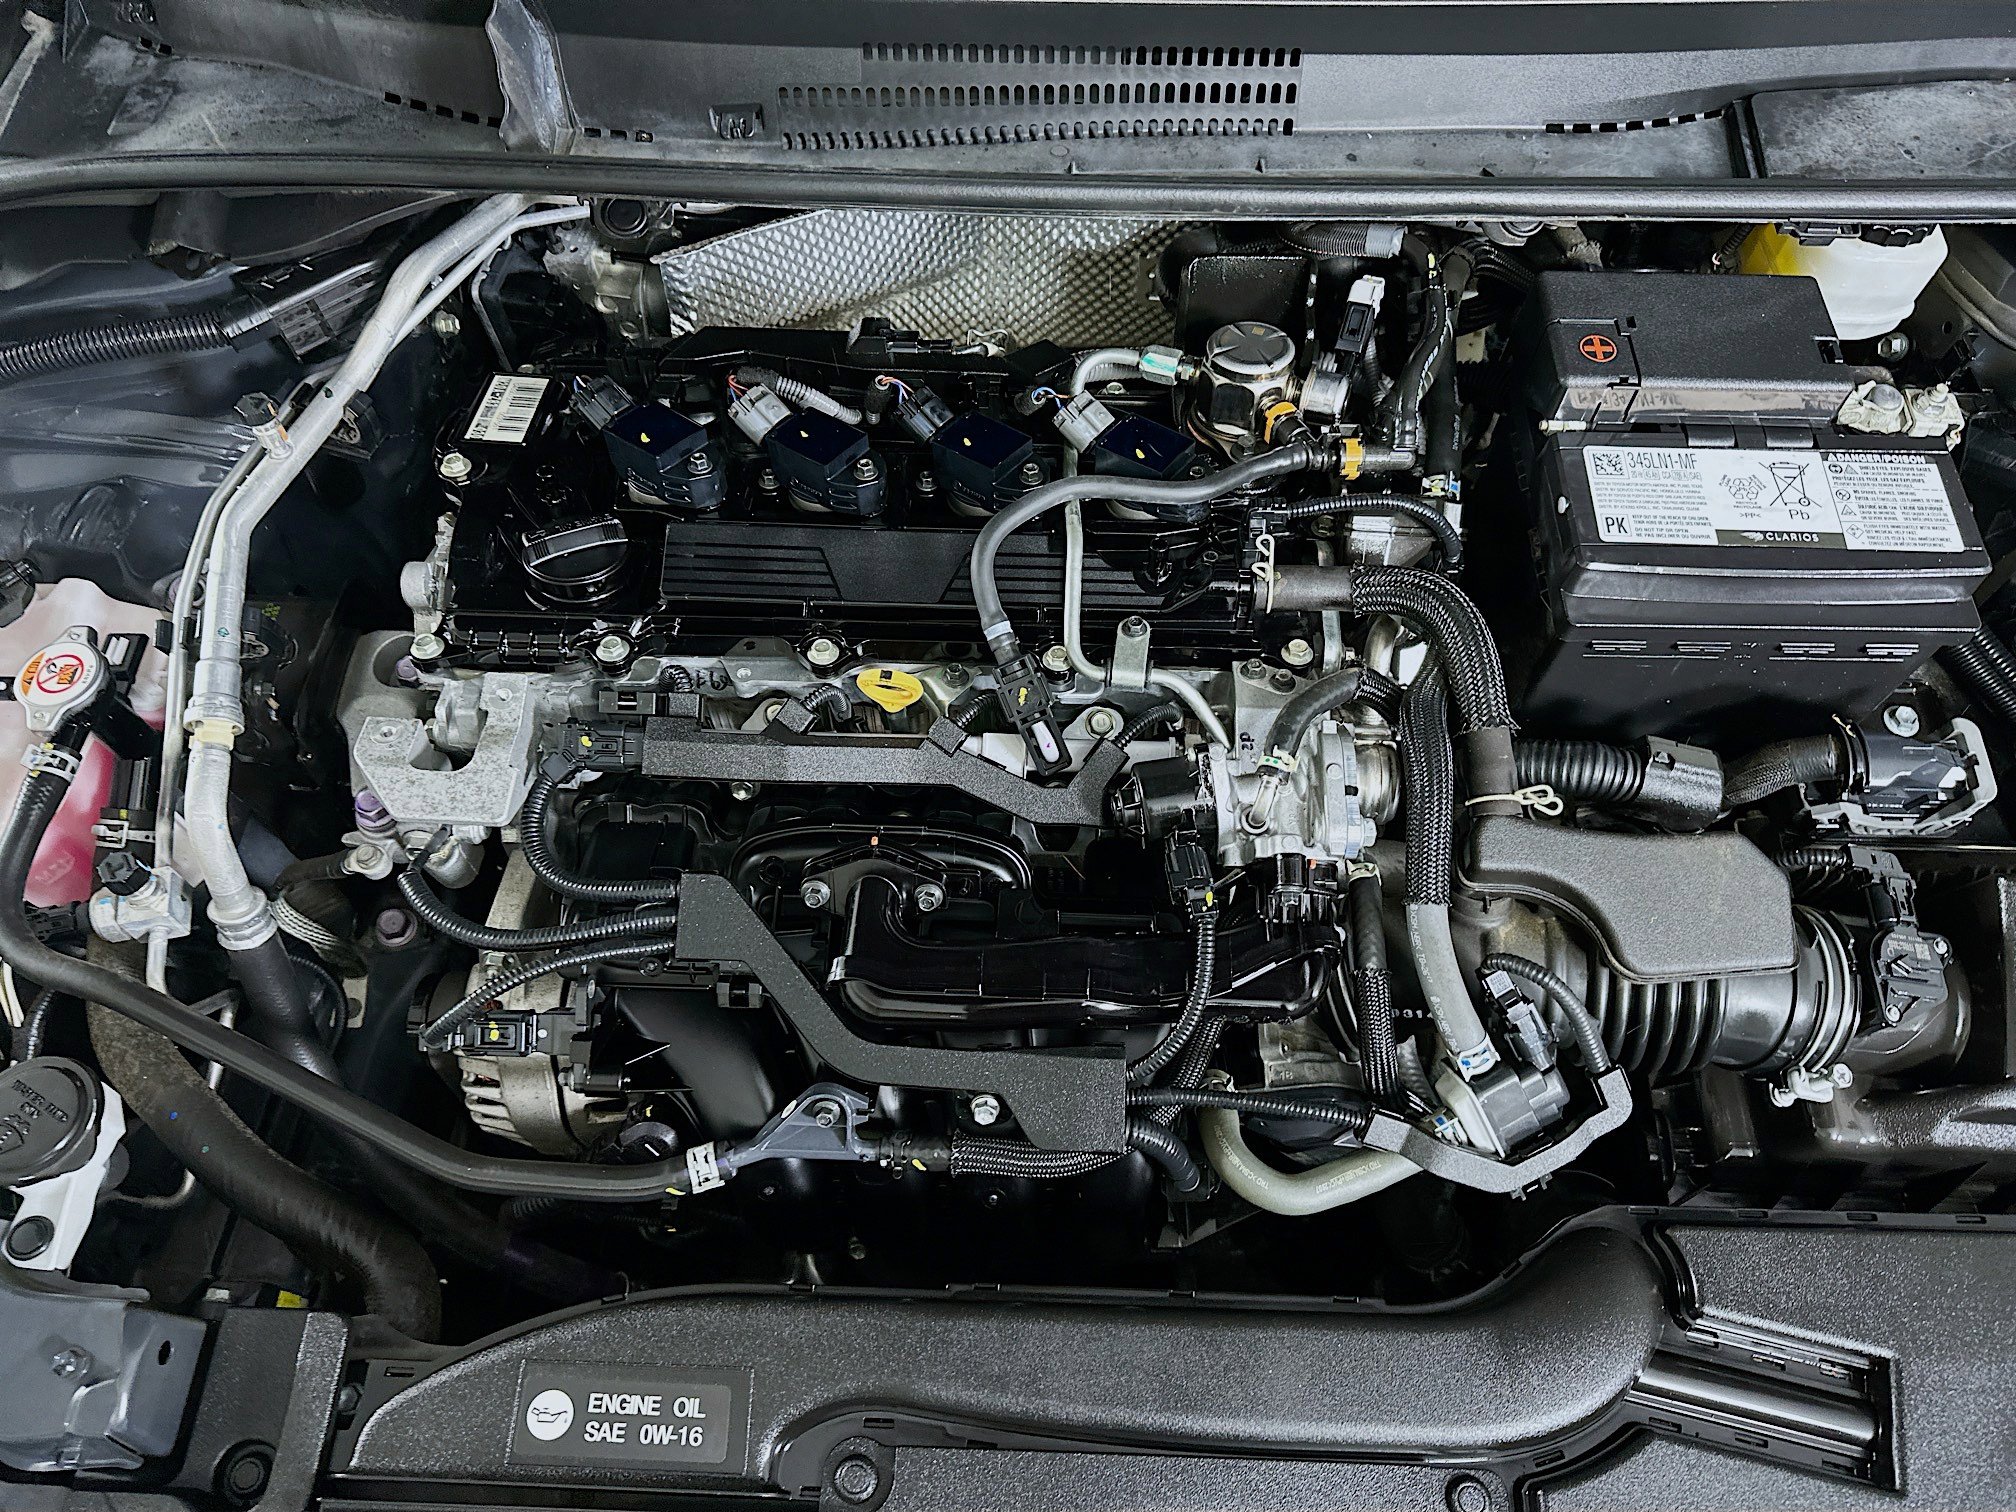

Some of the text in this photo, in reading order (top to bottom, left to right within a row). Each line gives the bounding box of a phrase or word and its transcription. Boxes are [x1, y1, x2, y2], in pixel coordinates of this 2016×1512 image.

[1628, 452, 1697, 469] 345LN1-MF
[1837, 453, 1926, 464] DANGER/POISON
[1788, 509, 1810, 520] Pb
[1604, 516, 1628, 534] PK
[1766, 532, 1819, 542] CLARIOS
[587, 1393, 706, 1419] ENGINE OIL
[584, 1421, 703, 1447] SAE 0W-16
